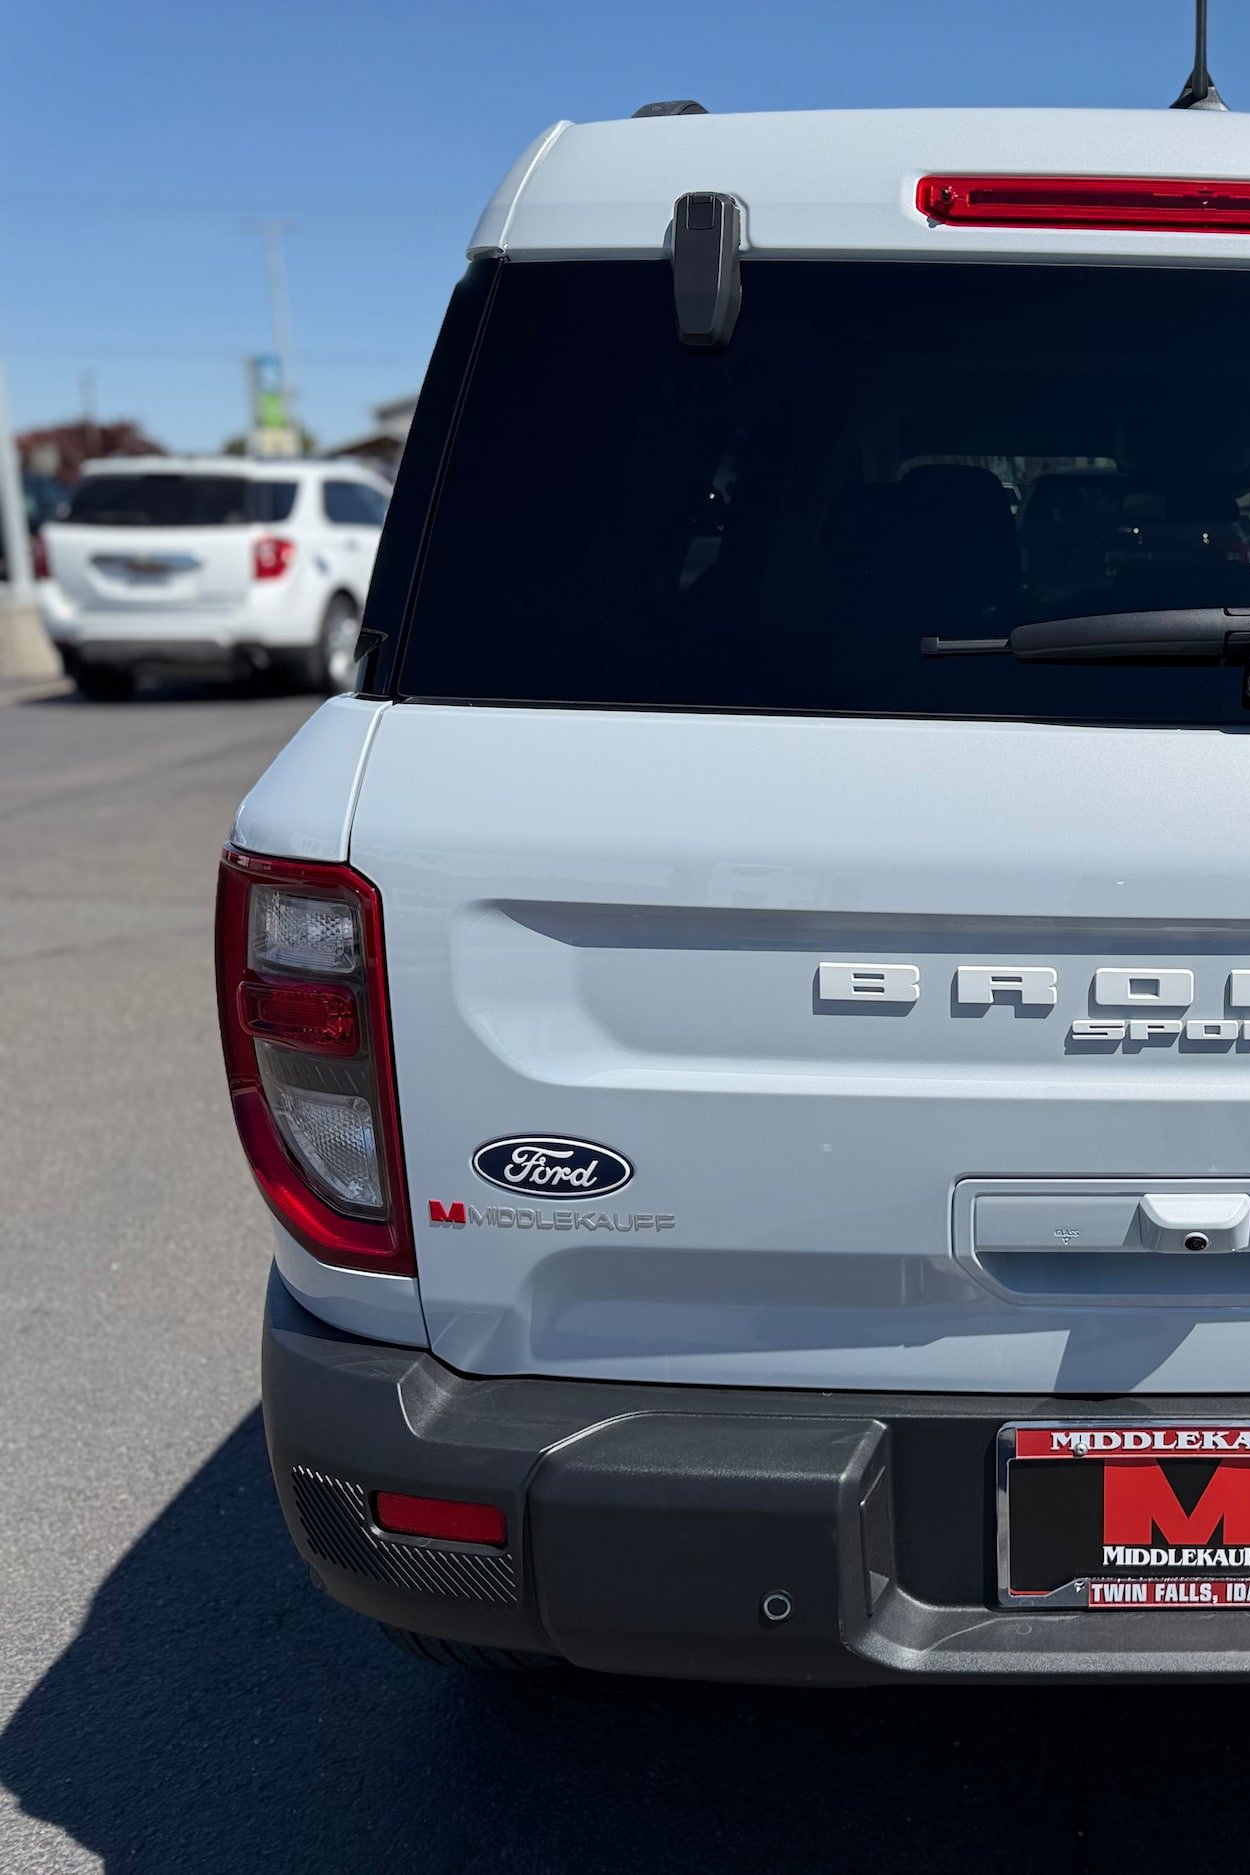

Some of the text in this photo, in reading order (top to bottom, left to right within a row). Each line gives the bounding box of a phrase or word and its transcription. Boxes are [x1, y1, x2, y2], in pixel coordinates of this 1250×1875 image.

[504, 1146, 599, 1188] Ford
[429, 1200, 676, 1232] M MIDDLEKAUFF
[1091, 1583, 1147, 1602] TWIN
[1154, 1582, 1218, 1604] FALLS,
